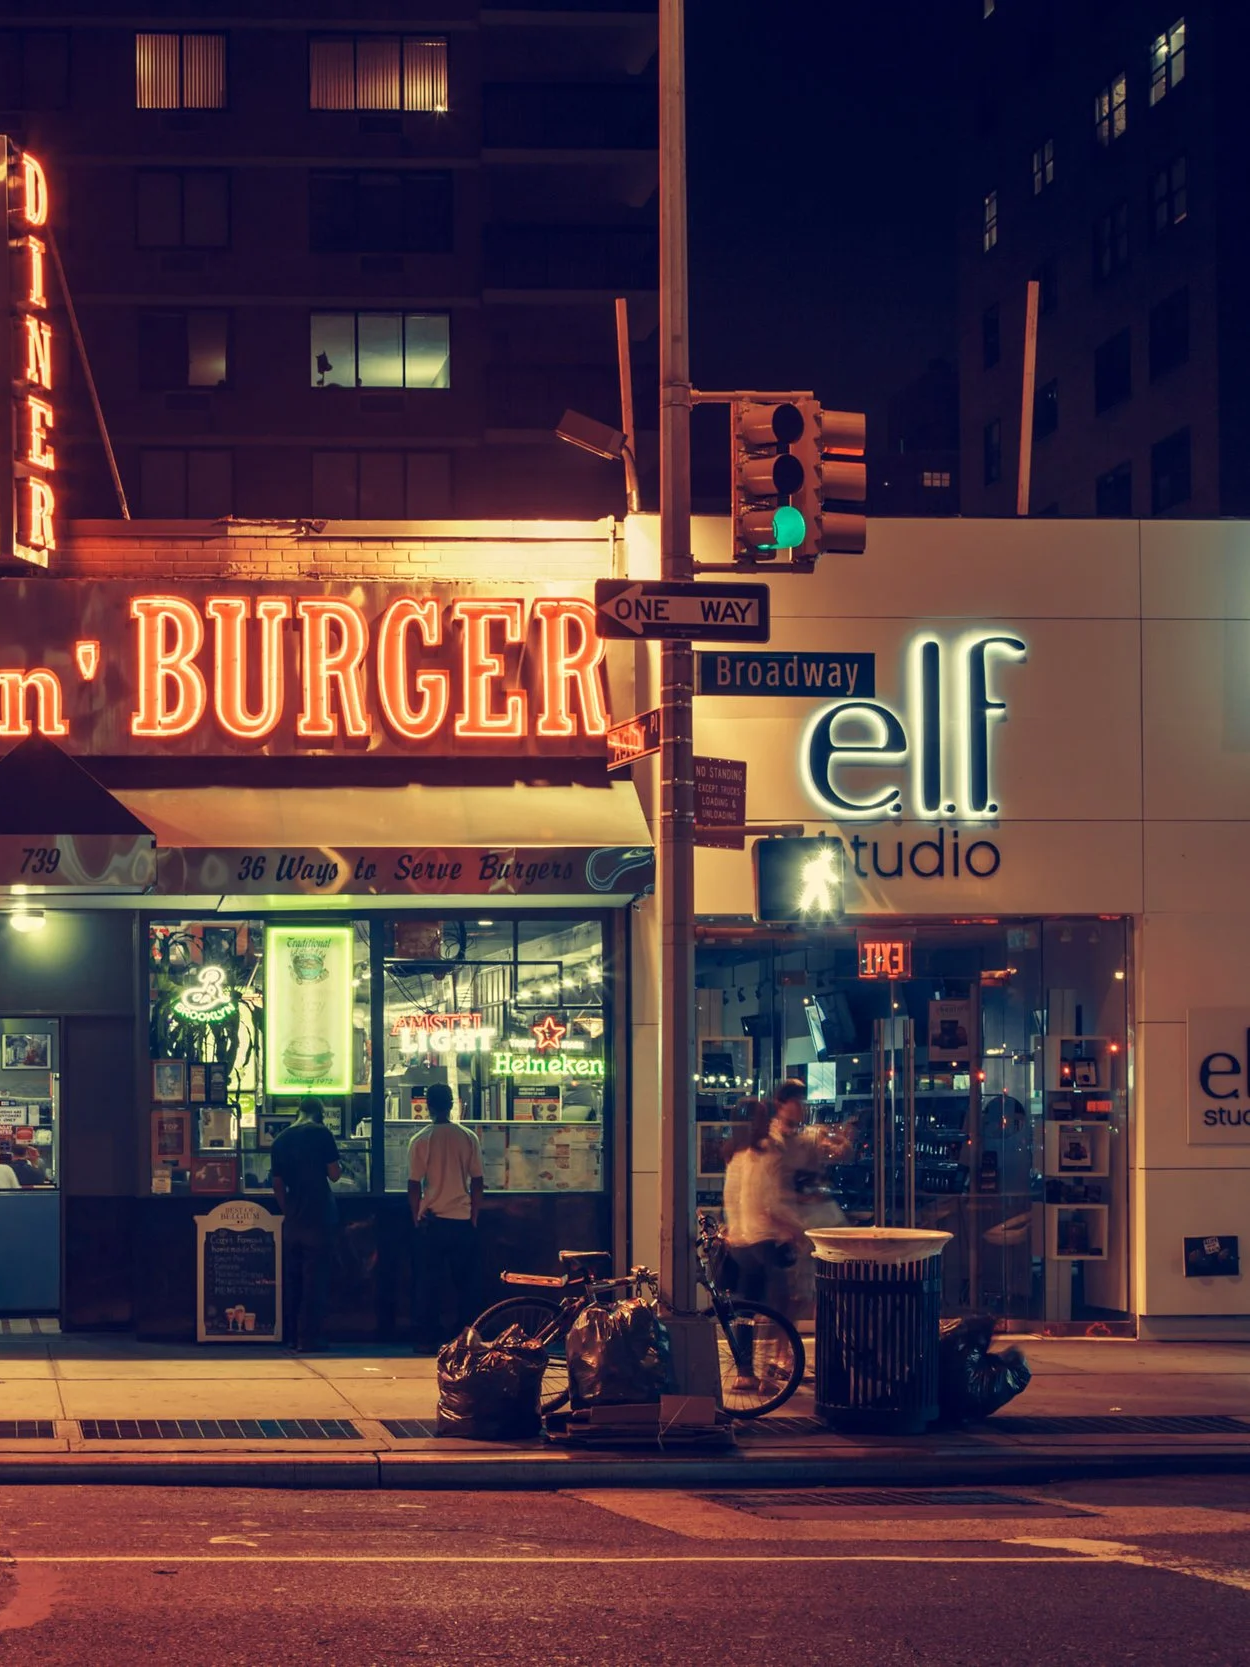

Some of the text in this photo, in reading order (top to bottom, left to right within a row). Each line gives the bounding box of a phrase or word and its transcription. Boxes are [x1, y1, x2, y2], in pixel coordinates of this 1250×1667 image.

[22, 152, 57, 551] DINER
[614, 599, 753, 622] ONE WAY
[130, 596, 612, 739] BURGER
[716, 655, 860, 696] Broadway
[695, 765, 743, 782] NO STANDING
[698, 783, 719, 793] EXCEPT
[701, 796, 737, 808] LOADING &
[701, 810, 737, 820] UNLOADING
[19, 848, 61, 875] 739
[846, 827, 1001, 879] tudio
[237, 854, 573, 886] 36 Ways to Serve Burgers
[286, 937, 332, 948] Traditional
[174, 1002, 236, 1021] BROOKLYN
[400, 1027, 496, 1052] LIGHT
[492, 1050, 606, 1077] Heineken
